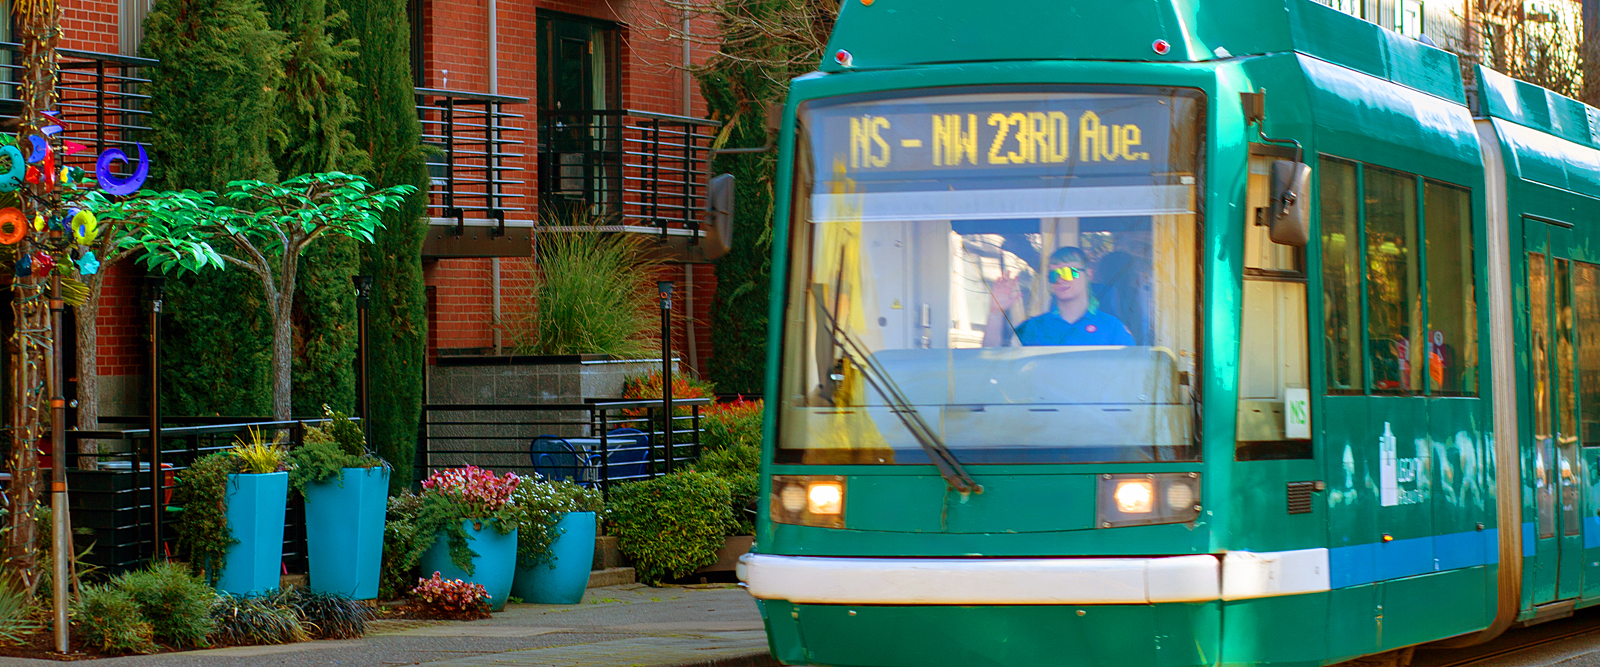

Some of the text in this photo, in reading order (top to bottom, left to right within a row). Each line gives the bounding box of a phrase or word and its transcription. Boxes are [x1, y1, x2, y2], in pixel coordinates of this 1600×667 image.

[849, 116, 891, 168] NS
[931, 113, 978, 166] NW
[987, 111, 1069, 165] 23RD
[1079, 110, 1150, 162] Ave.
[1289, 400, 1306, 425] NS
